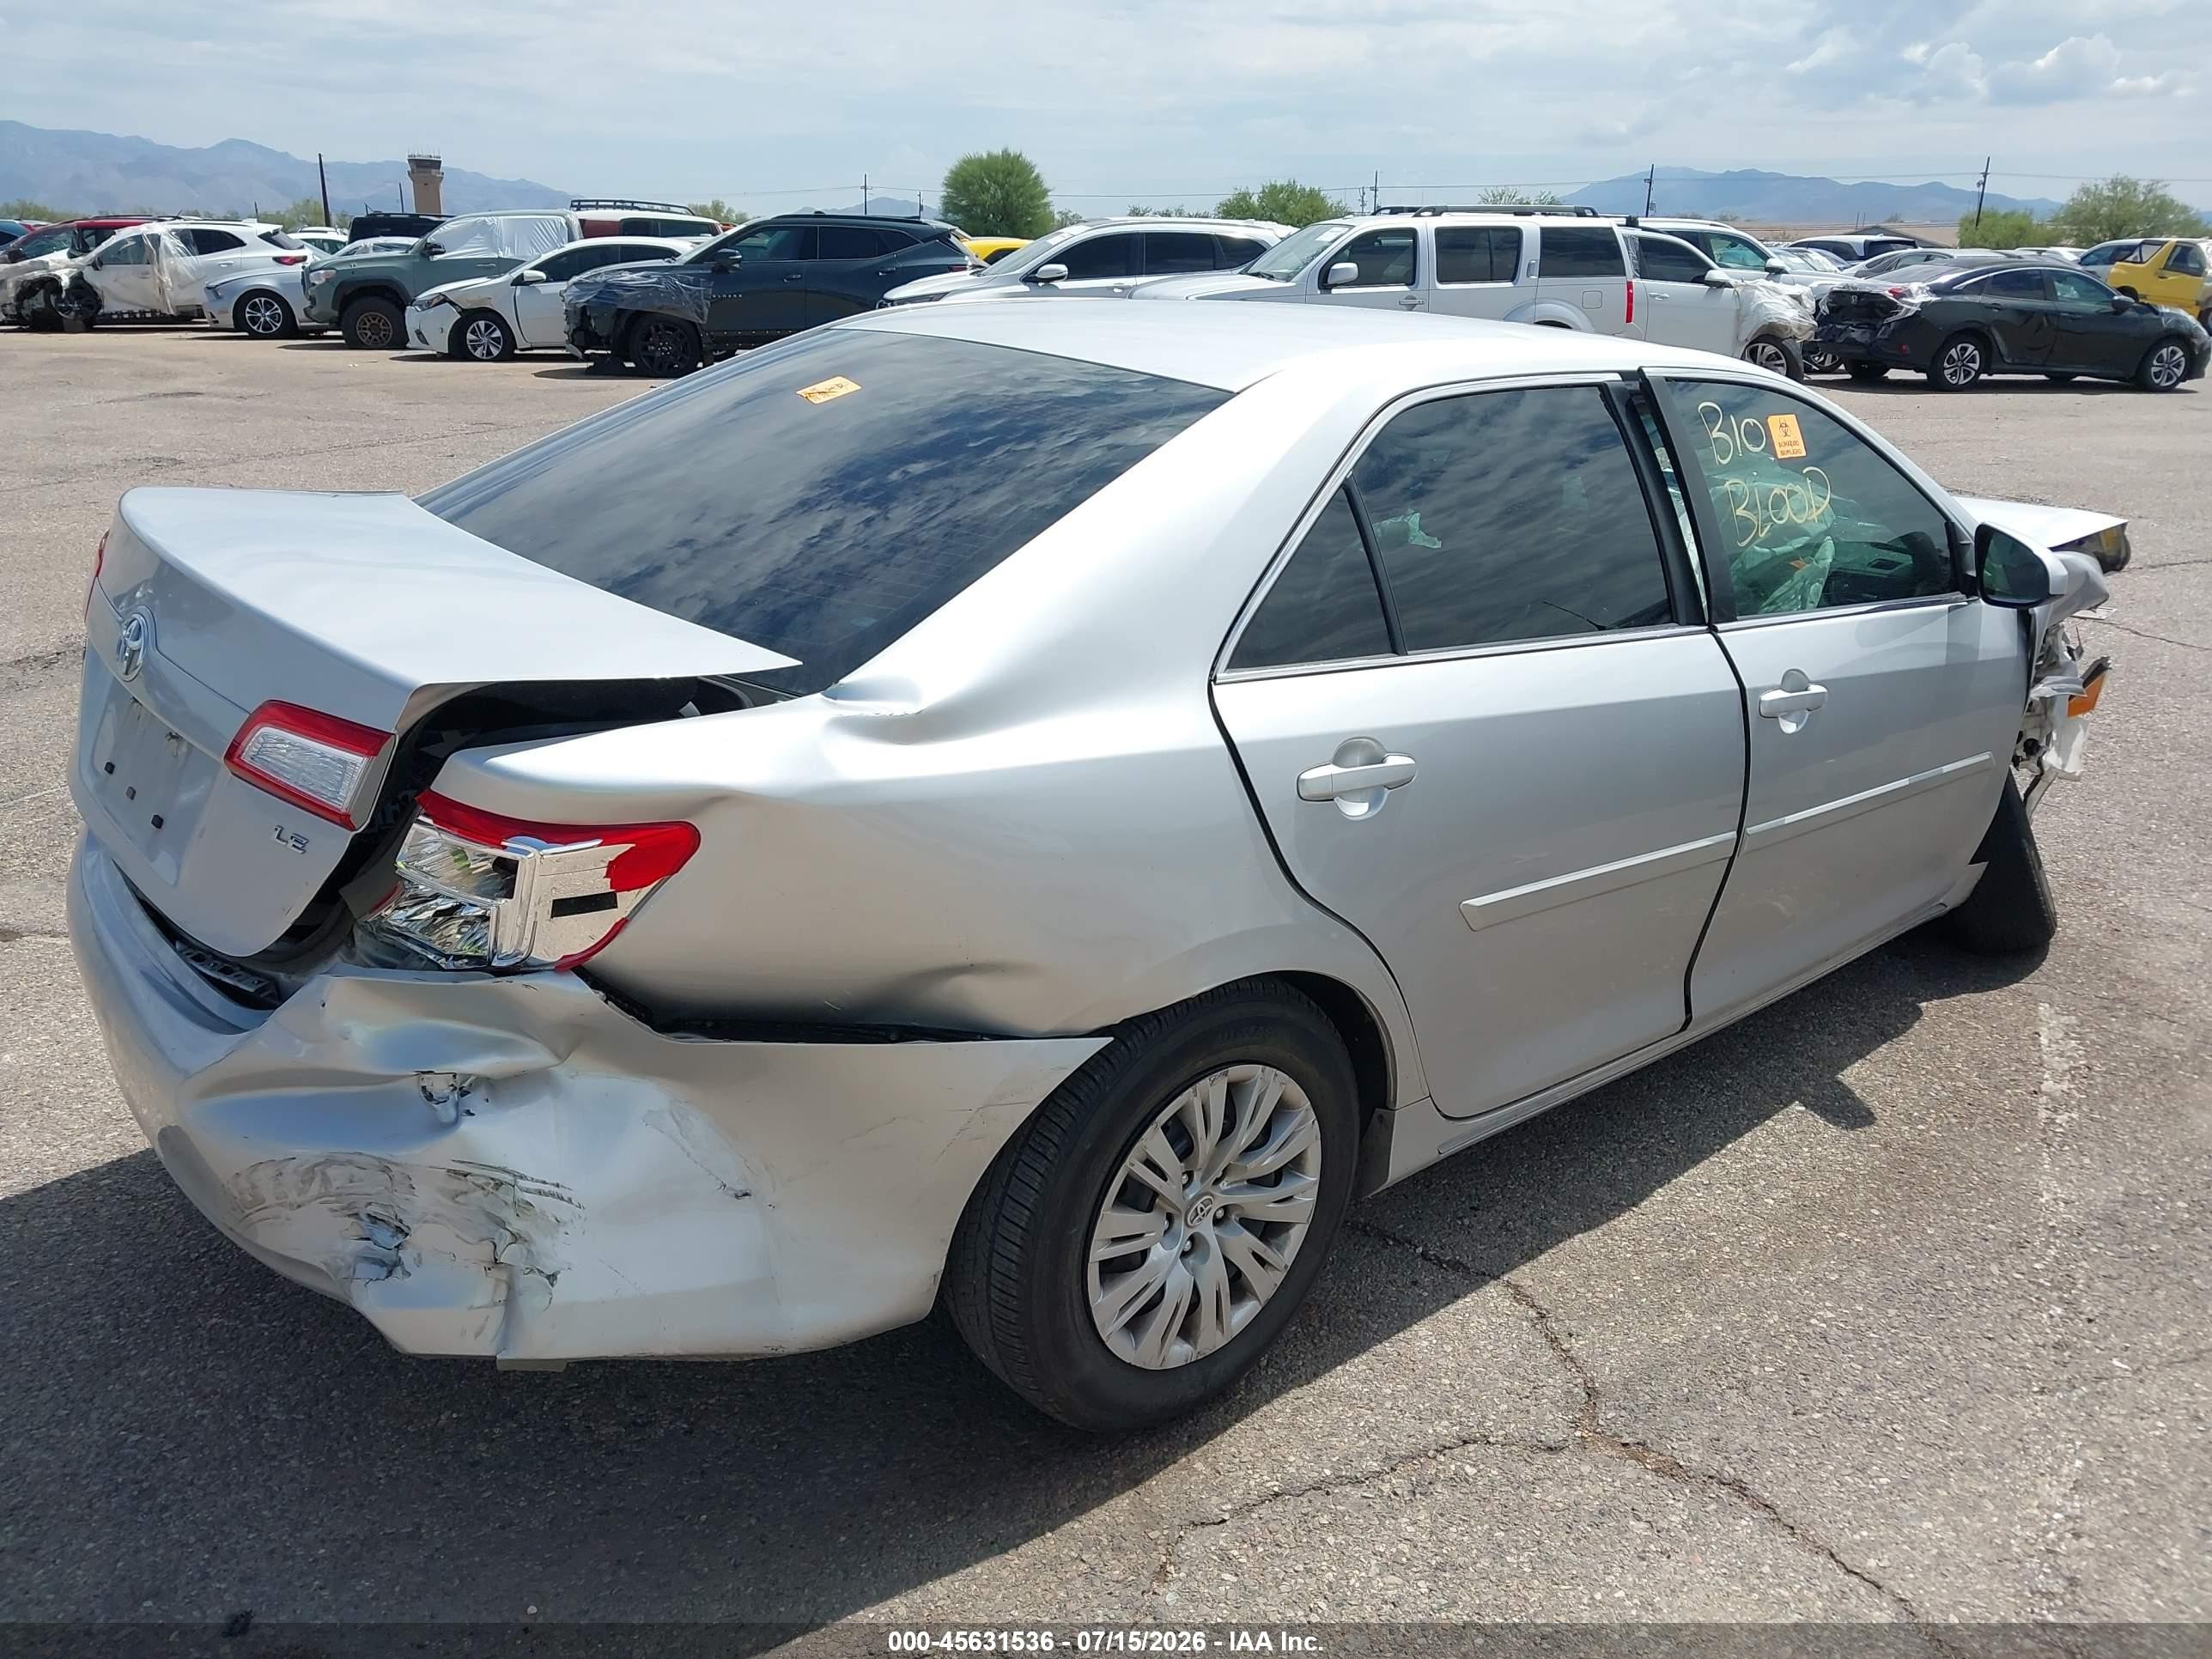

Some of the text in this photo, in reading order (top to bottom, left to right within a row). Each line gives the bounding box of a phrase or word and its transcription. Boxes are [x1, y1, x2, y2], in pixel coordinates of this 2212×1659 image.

[1698, 401, 1765, 465] BIO
[1724, 466, 1831, 547] BLOOD
[274, 824, 310, 854] LE
